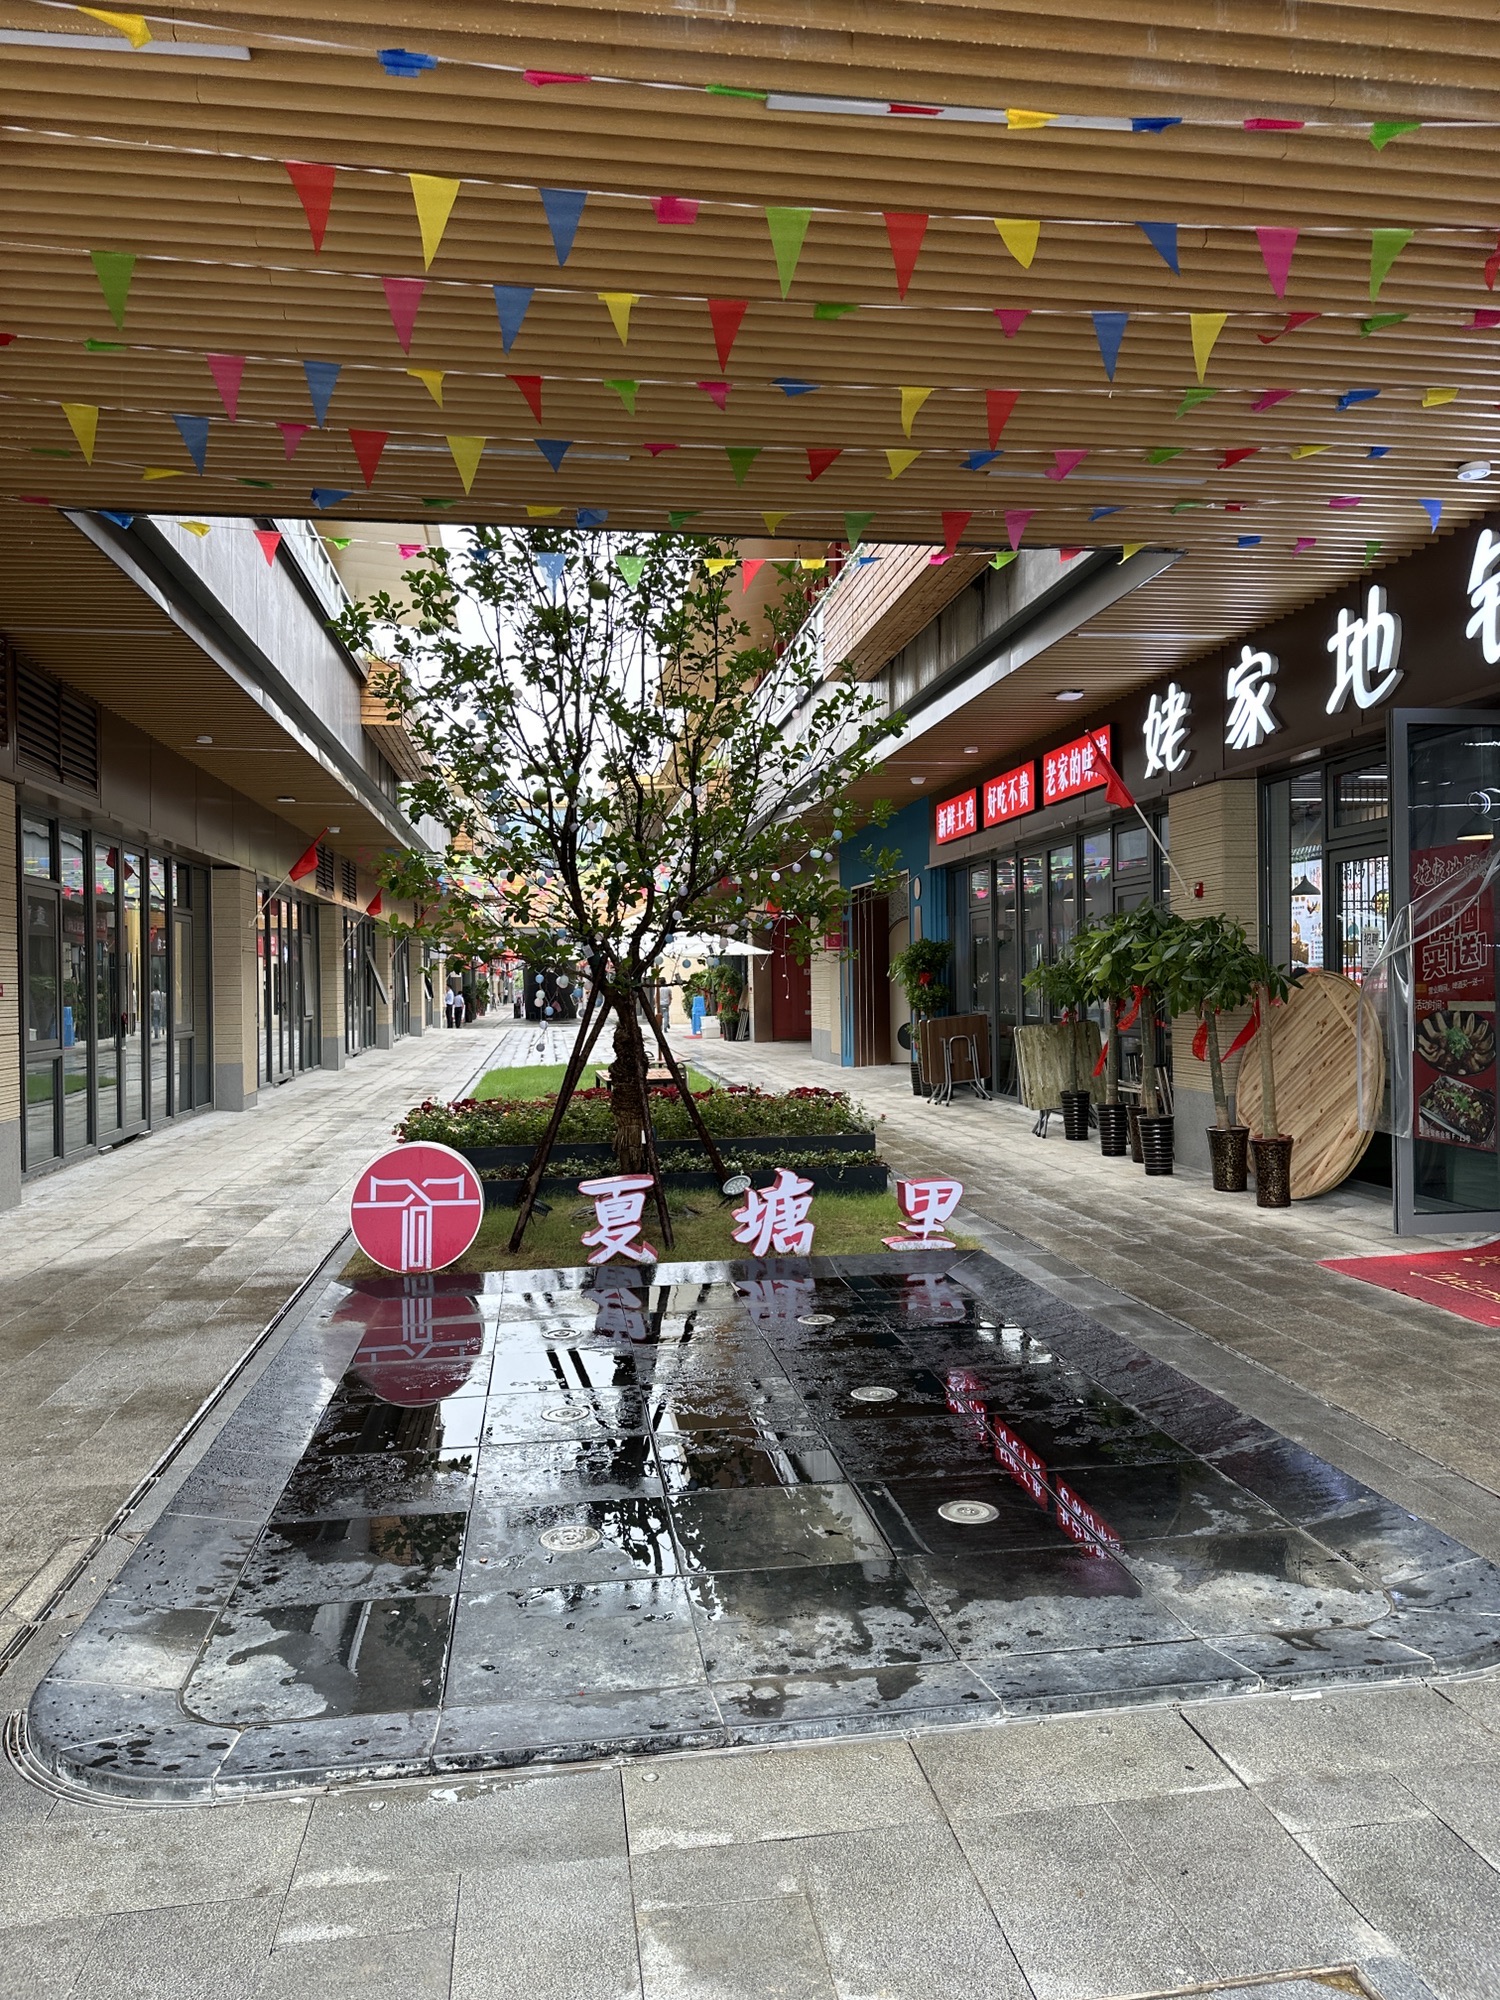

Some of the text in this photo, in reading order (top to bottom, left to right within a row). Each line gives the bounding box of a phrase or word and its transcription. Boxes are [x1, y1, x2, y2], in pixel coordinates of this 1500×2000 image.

[937, 796, 975, 839] 新鲜土鸡
[986, 770, 1031, 819] 好吃不贵
[1363, 932, 1379, 946] 招聘
[1422, 931, 1488, 981] 买1送1
[578, 1167, 964, 1265] 夏塘里
